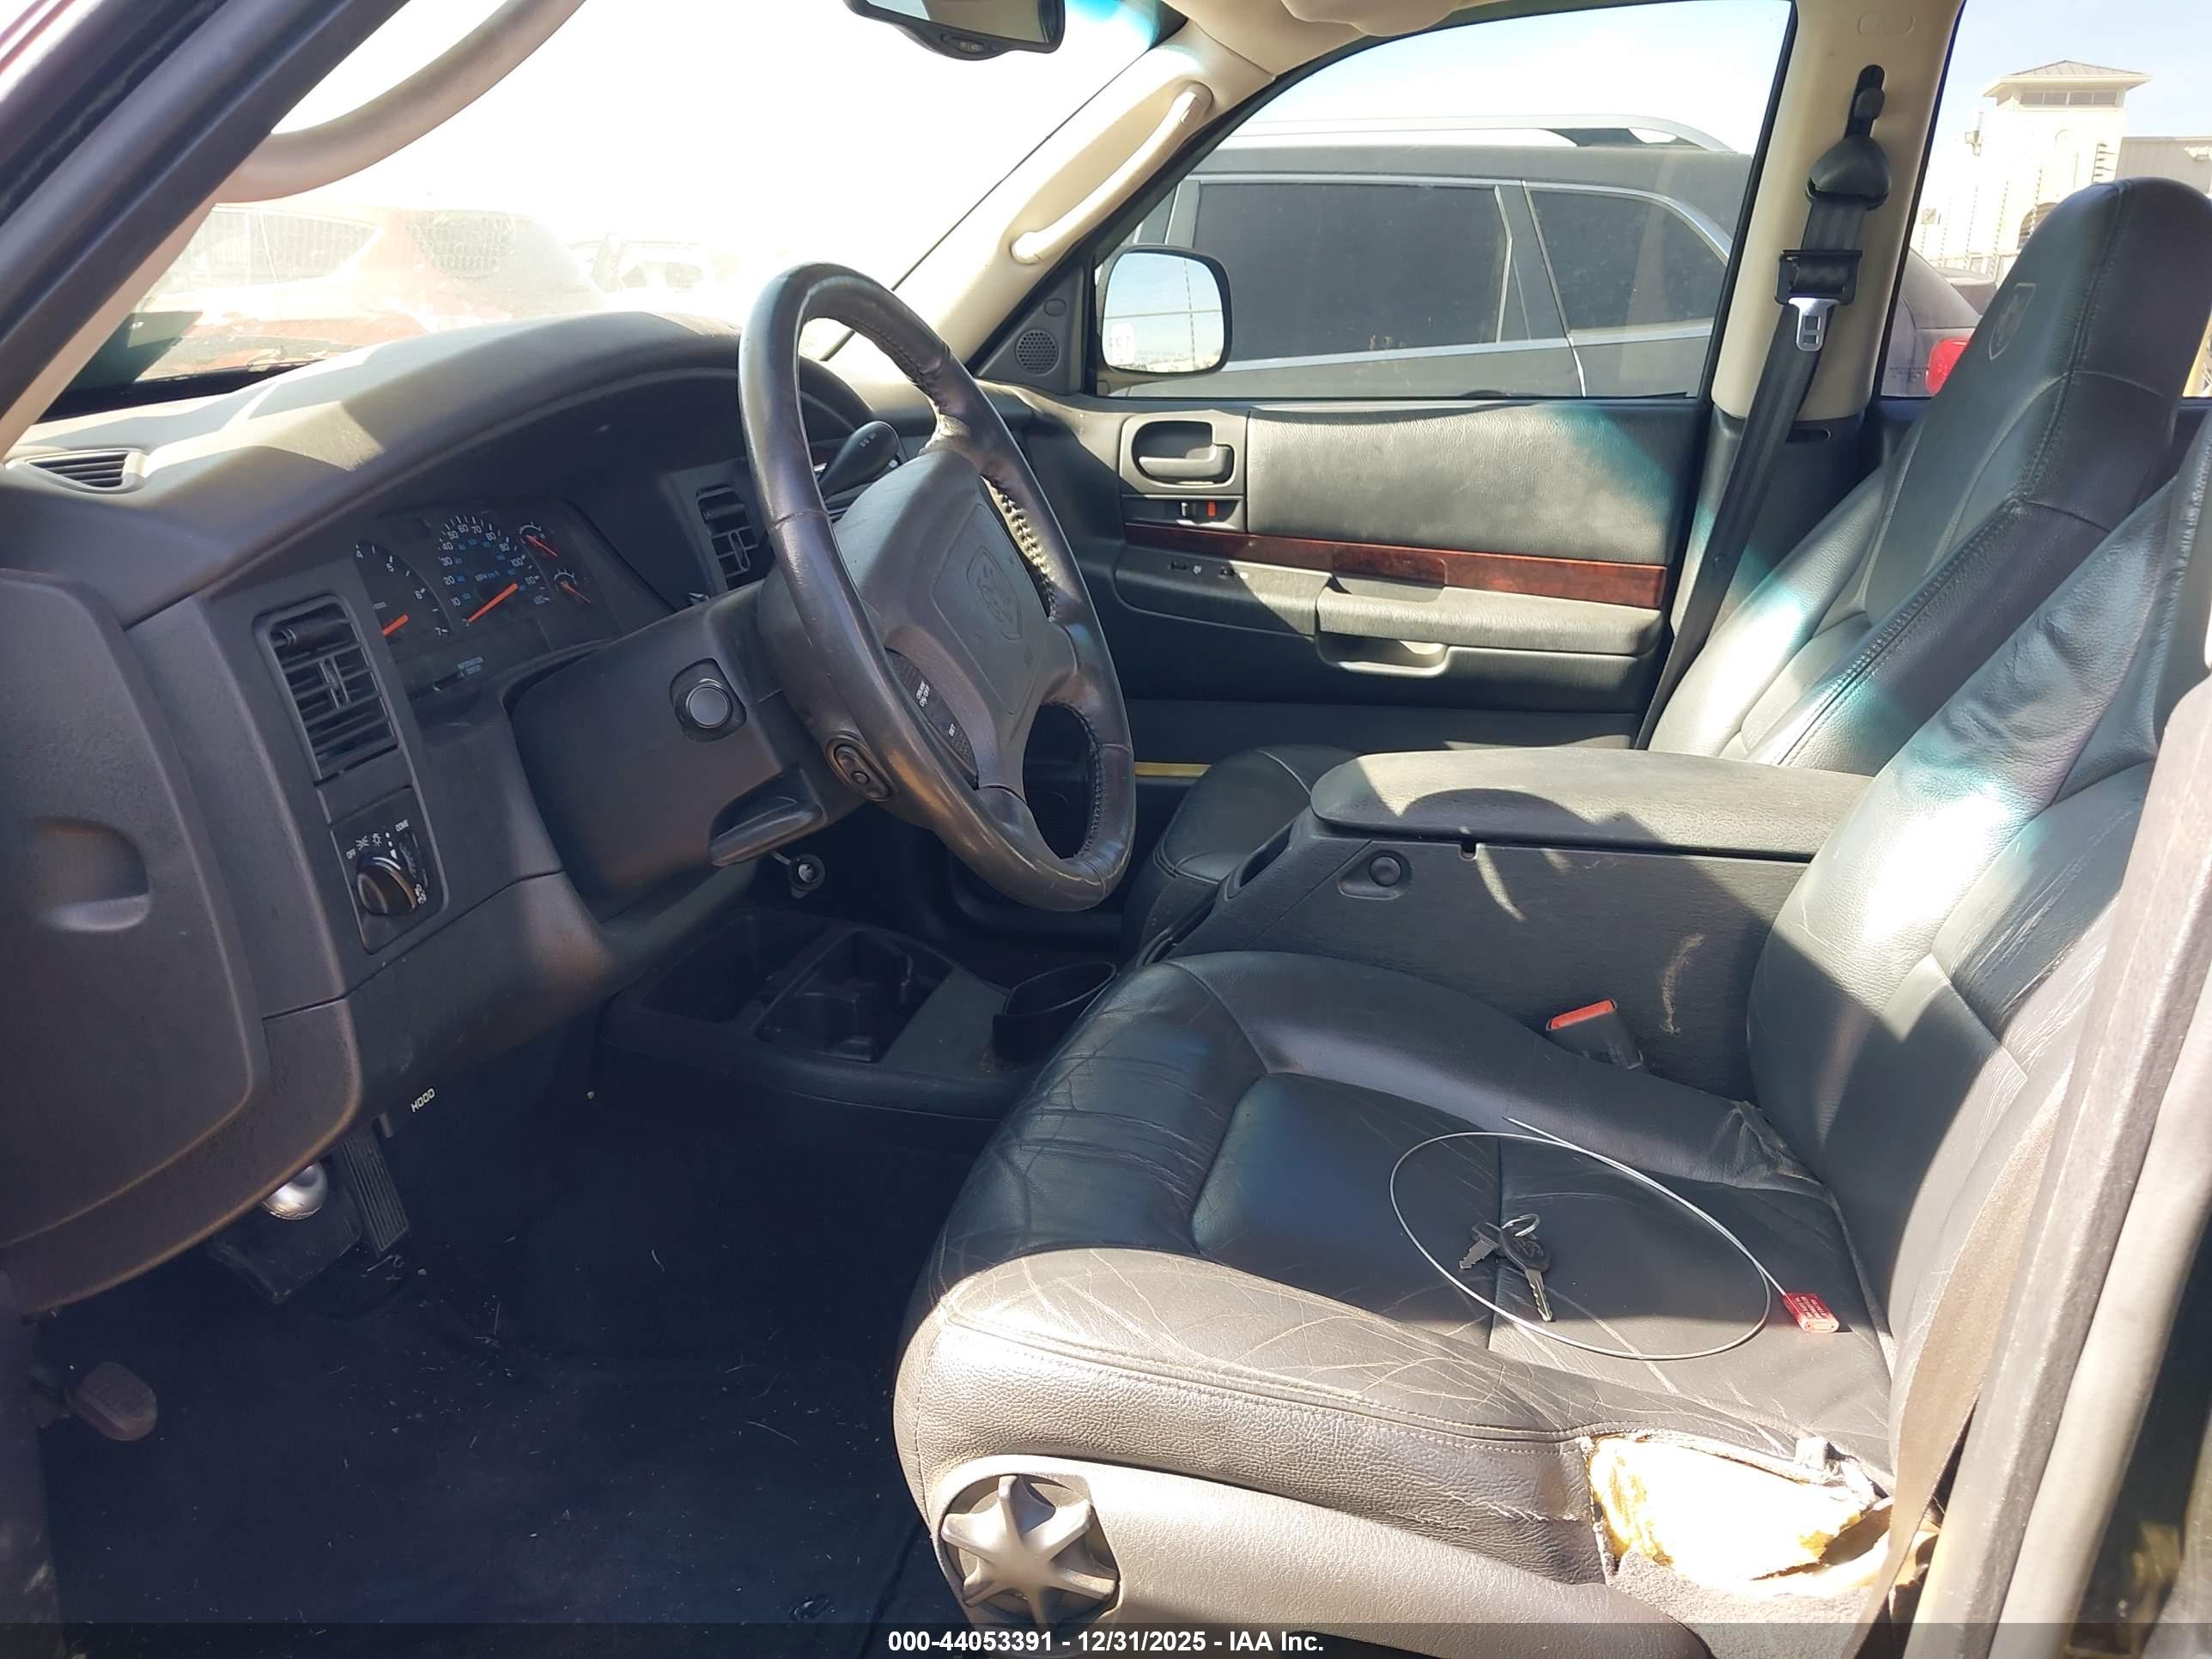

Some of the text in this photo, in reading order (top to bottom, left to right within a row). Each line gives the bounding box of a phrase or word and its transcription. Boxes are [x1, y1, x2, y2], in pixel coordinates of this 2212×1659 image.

[457, 524, 469, 533] 60
[471, 526, 483, 535] 70
[447, 531, 459, 540] 50
[442, 542, 453, 550] 40
[356, 550, 363, 559] 4
[441, 556, 453, 567] 30
[386, 562, 394, 573] 5
[443, 575, 455, 586] 20
[414, 590, 423, 600] 6
[451, 597, 461, 607] 10
[434, 628, 442, 636] 7
[410, 1088, 435, 1113] HOOD
